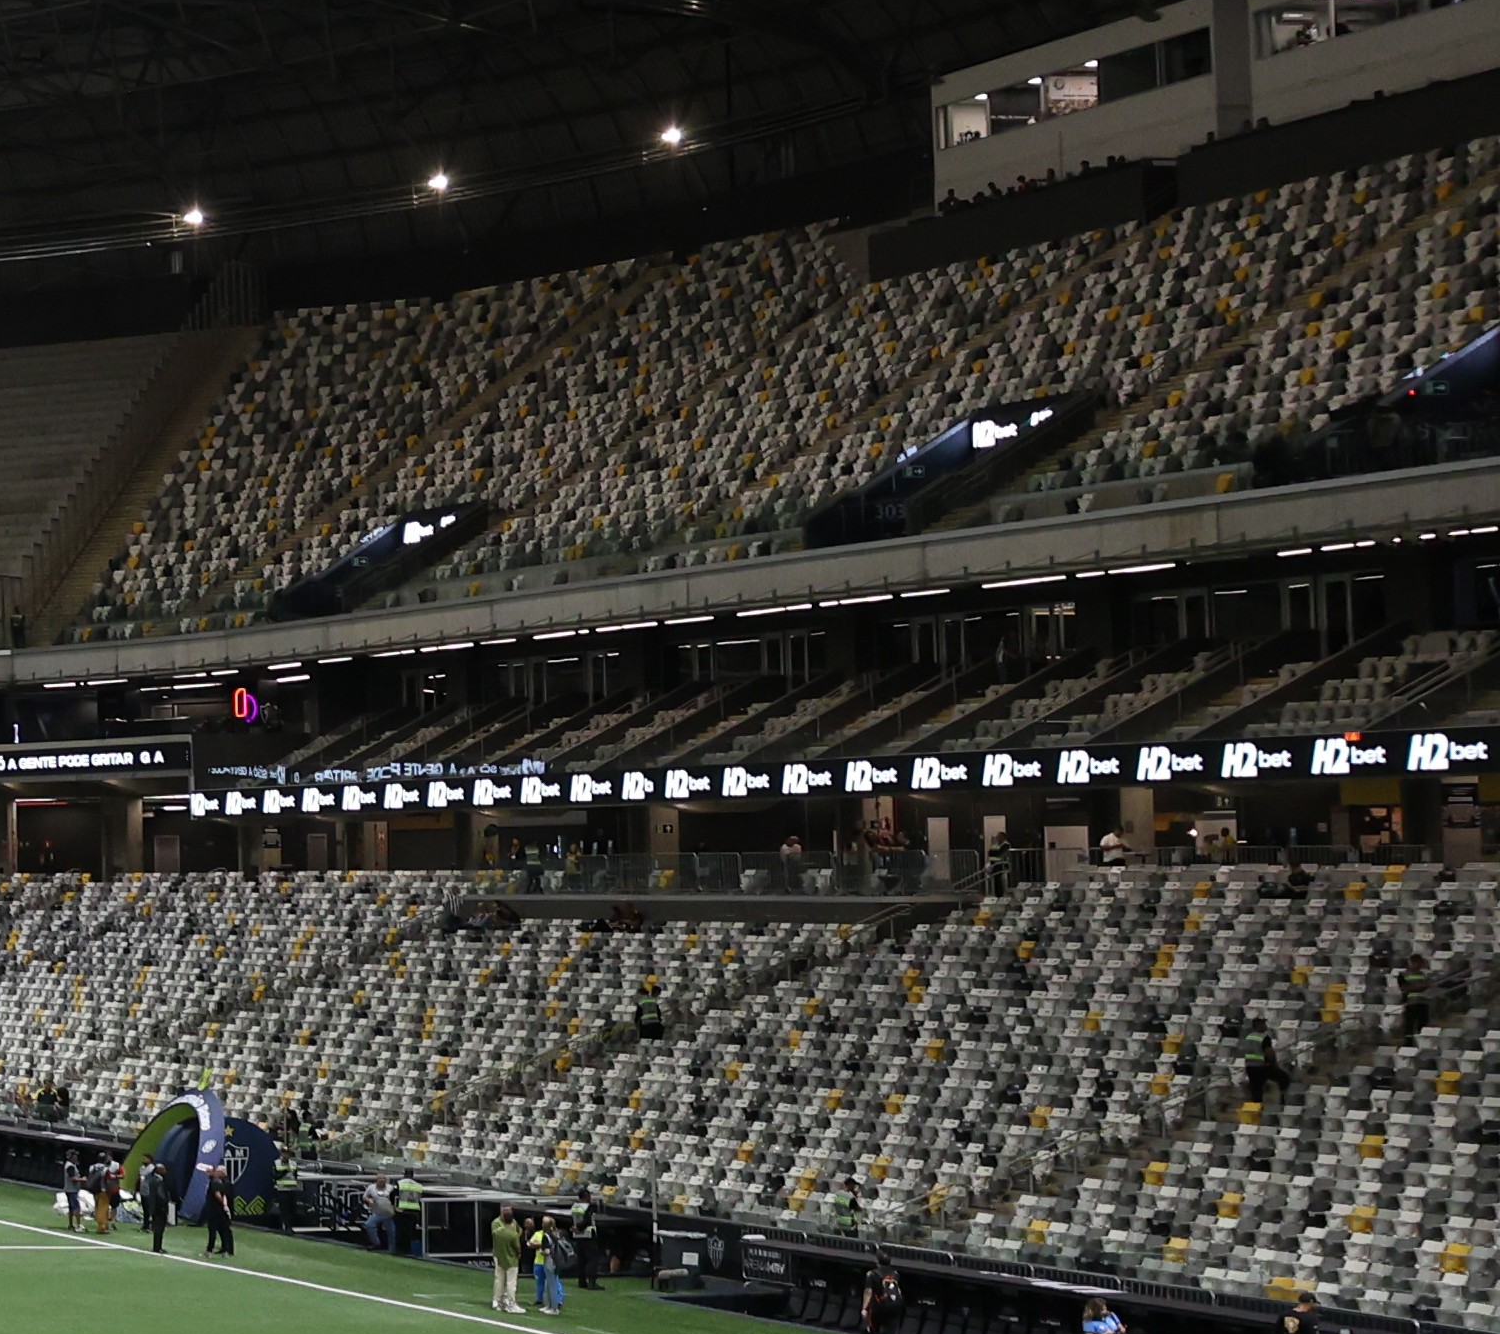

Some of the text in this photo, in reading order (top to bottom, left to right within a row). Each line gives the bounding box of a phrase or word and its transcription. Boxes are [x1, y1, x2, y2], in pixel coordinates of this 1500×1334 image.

[7, 758, 18, 770] A
[19, 756, 58, 770] GENTE
[58, 754, 90, 768] PODE
[91, 752, 134, 766] GRITAR
